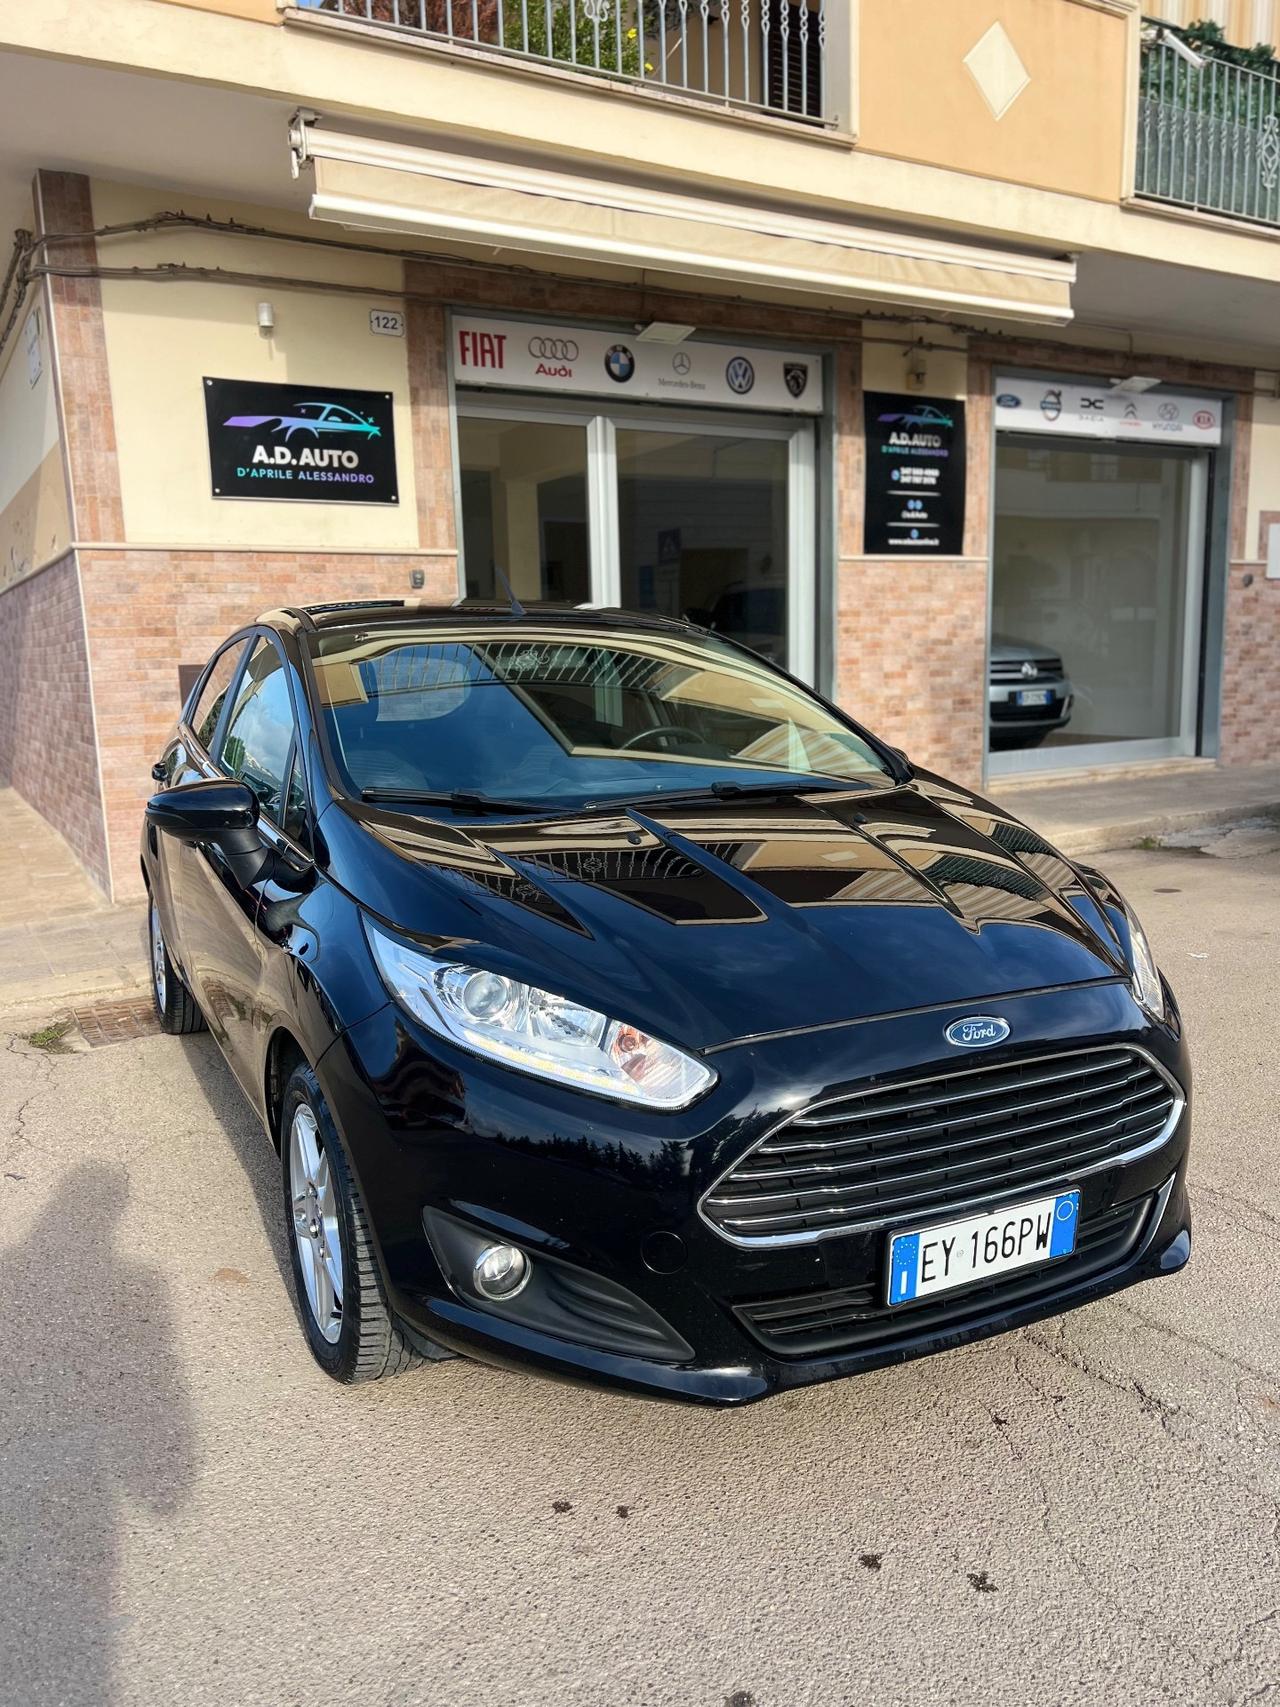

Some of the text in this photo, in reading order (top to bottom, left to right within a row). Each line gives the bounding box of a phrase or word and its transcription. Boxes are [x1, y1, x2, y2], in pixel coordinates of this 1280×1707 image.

[374, 316, 398, 330] 122
[459, 330, 507, 369] FIAT
[535, 363, 573, 378] Audi
[236, 467, 375, 484] D'APRILE ALESSANDRO
[962, 1022, 997, 1041] Ford
[921, 1236, 956, 1284] EY
